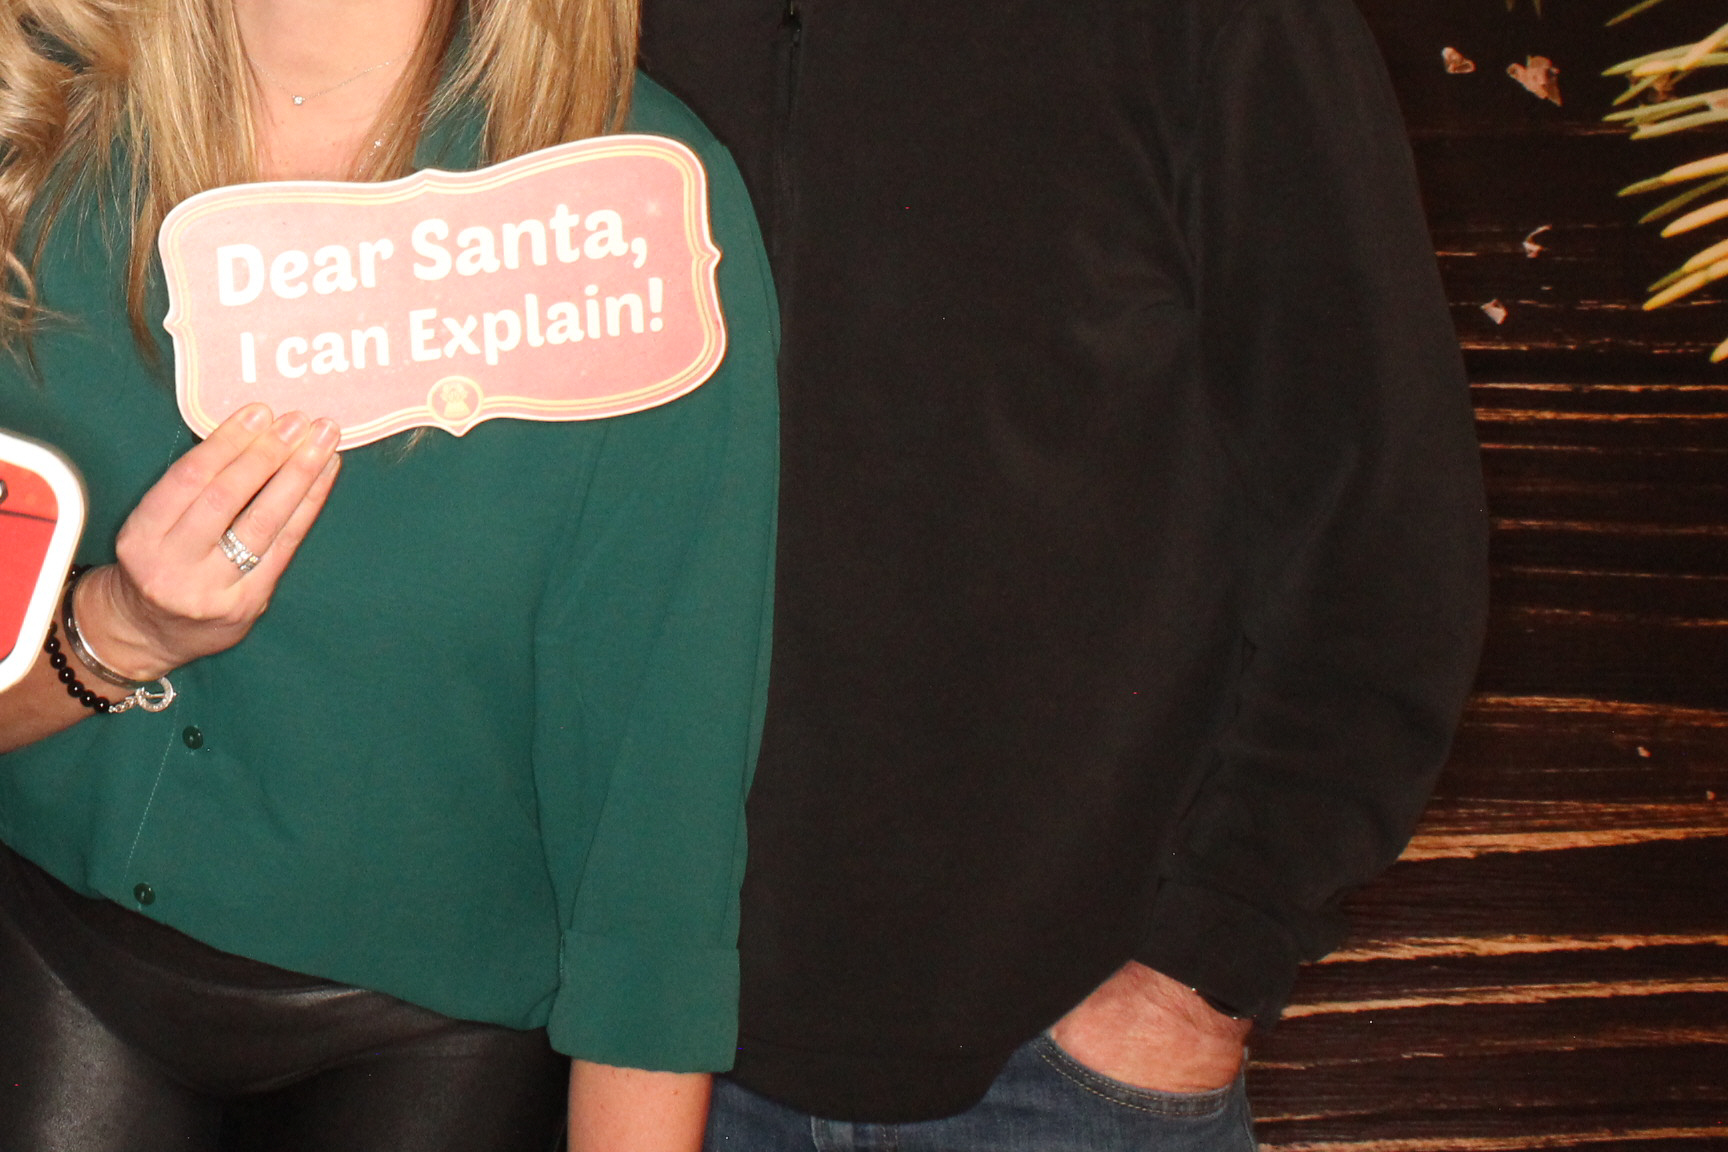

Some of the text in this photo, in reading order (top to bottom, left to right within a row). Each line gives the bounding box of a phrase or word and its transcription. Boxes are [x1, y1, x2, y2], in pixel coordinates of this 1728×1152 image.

[216, 203, 647, 307] Dear Santa,
[239, 277, 664, 384] I can Explain!
